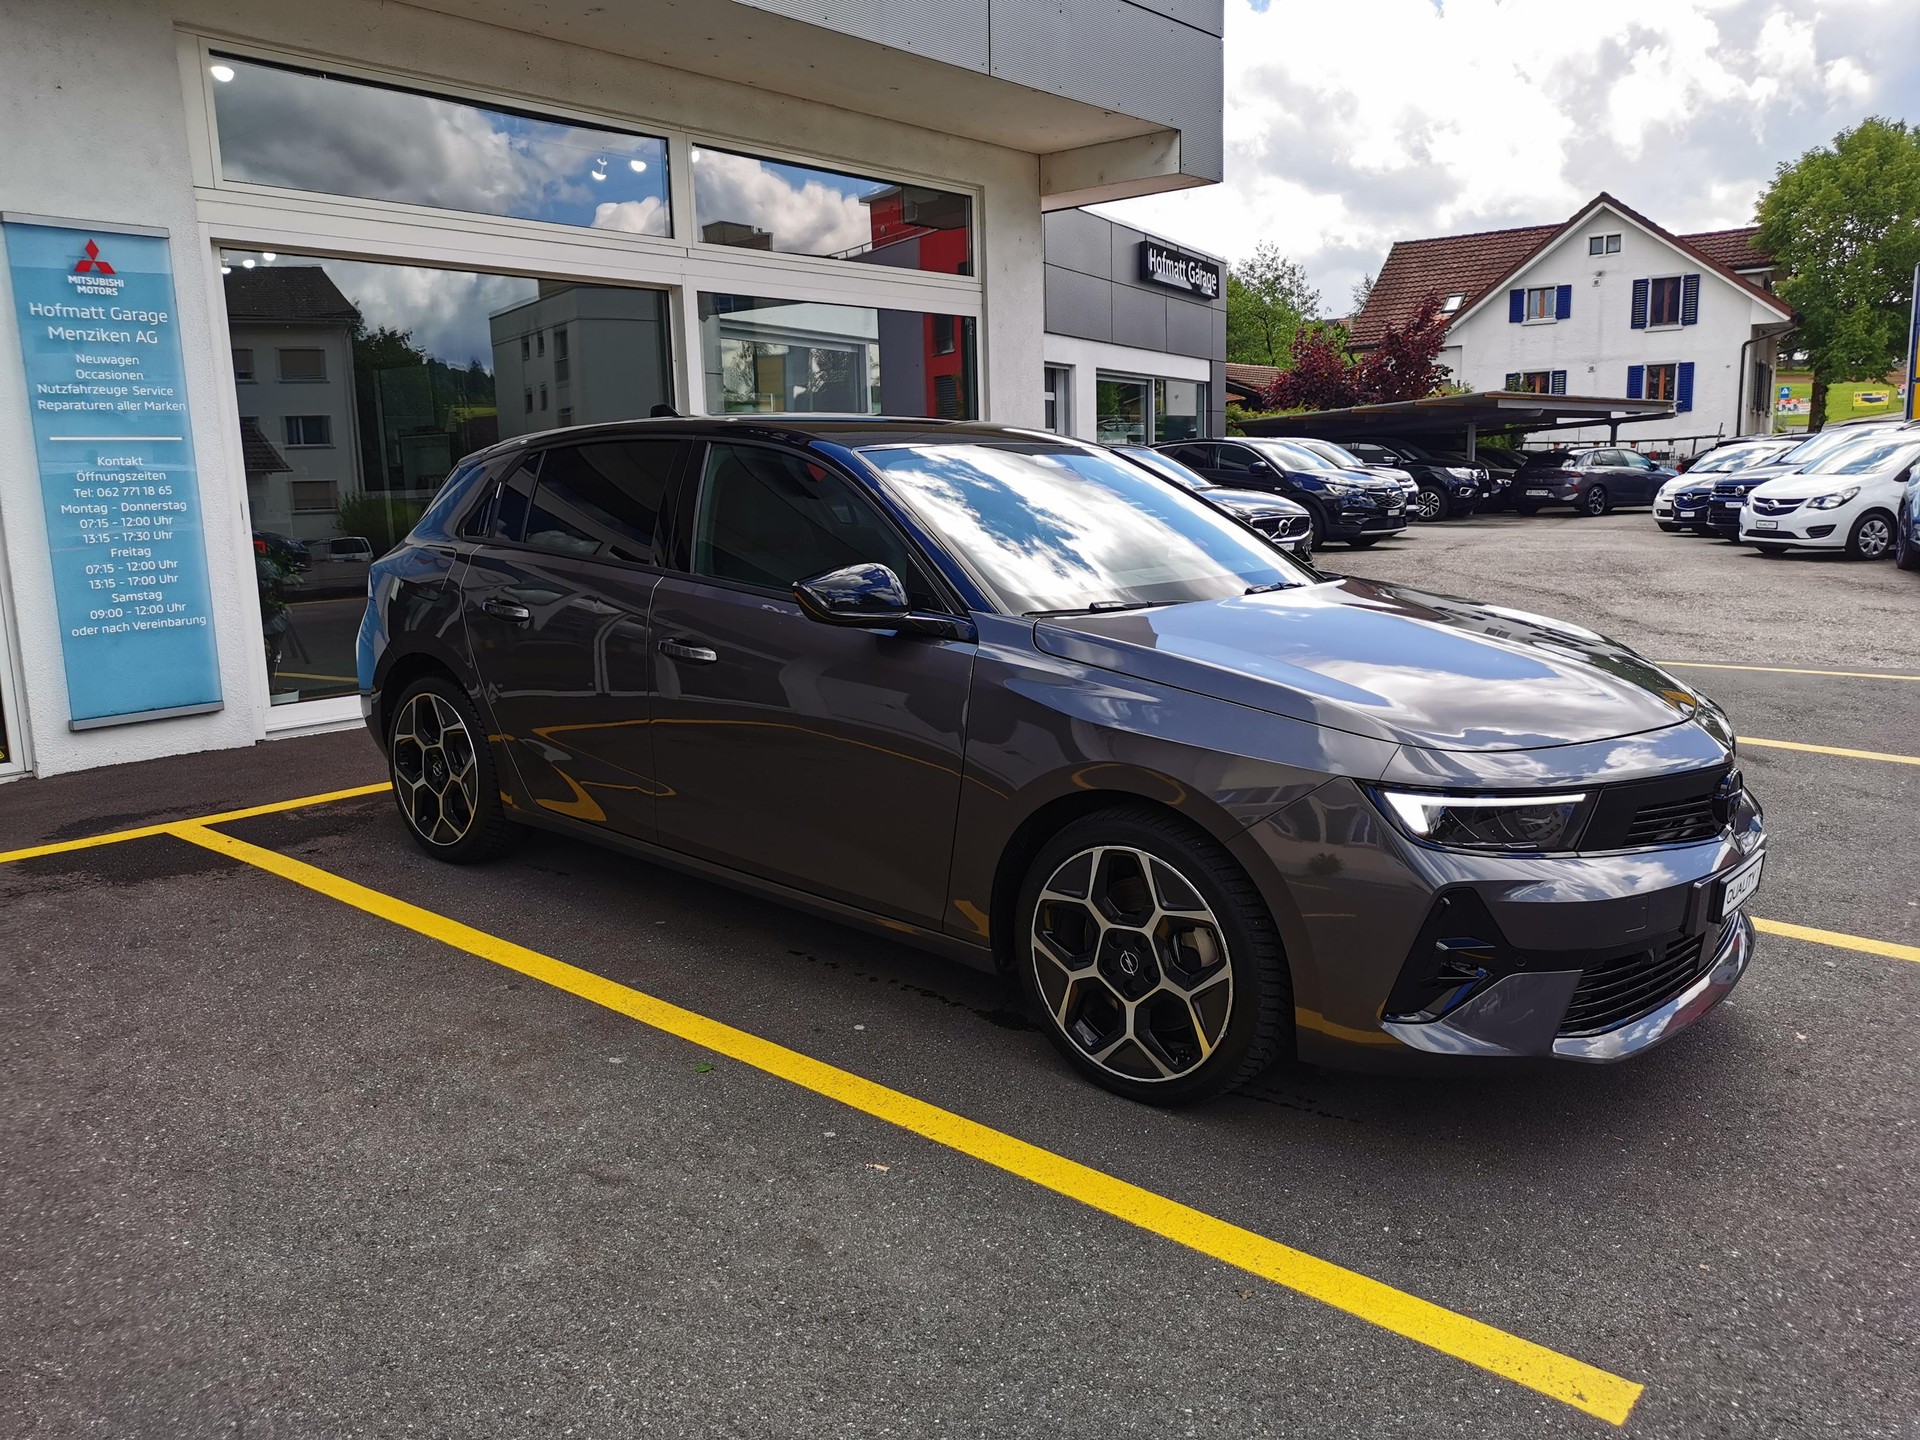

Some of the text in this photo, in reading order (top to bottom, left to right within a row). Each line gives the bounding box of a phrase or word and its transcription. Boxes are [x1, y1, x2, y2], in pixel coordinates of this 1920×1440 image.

[1149, 248, 1217, 294] Hofmatt Garage
[67, 275, 125, 288] MITSUBISHI
[77, 286, 118, 296] MOTORS
[29, 302, 168, 325] Hofmatt Garage
[47, 326, 158, 344] Menziken AG
[76, 354, 140, 367] Neuwagen
[75, 369, 144, 381] Occasionen
[37, 384, 174, 397] Nutzfahrzeuge Service
[38, 400, 186, 412] Reparaturen aller Marken
[97, 456, 144, 466] Kontakt
[76, 470, 166, 483] Öffnungszeiten
[73, 486, 172, 498] Tel: 062 771 18 65
[60, 504, 108, 515] Montag
[120, 501, 187, 511] Donnerstag
[79, 518, 109, 529] 07:15
[121, 517, 150, 527] 12:00
[153, 515, 173, 525] Uhr
[83, 533, 110, 544] 13:15
[122, 531, 150, 541] 17:30
[153, 530, 173, 540] Uhr
[110, 547, 152, 558] Freitag
[85, 563, 115, 575] 07:15
[126, 561, 156, 572] 12:00
[158, 559, 178, 569] Uhr
[88, 578, 116, 590] 13:15
[127, 575, 156, 586] 17:00
[159, 574, 179, 584] Uhr
[111, 590, 163, 603] Samstag
[90, 608, 123, 620] 09:00
[135, 605, 164, 616] 12:00
[166, 602, 187, 614] Uhr
[71, 616, 207, 637] oder nach Vereinbarung
